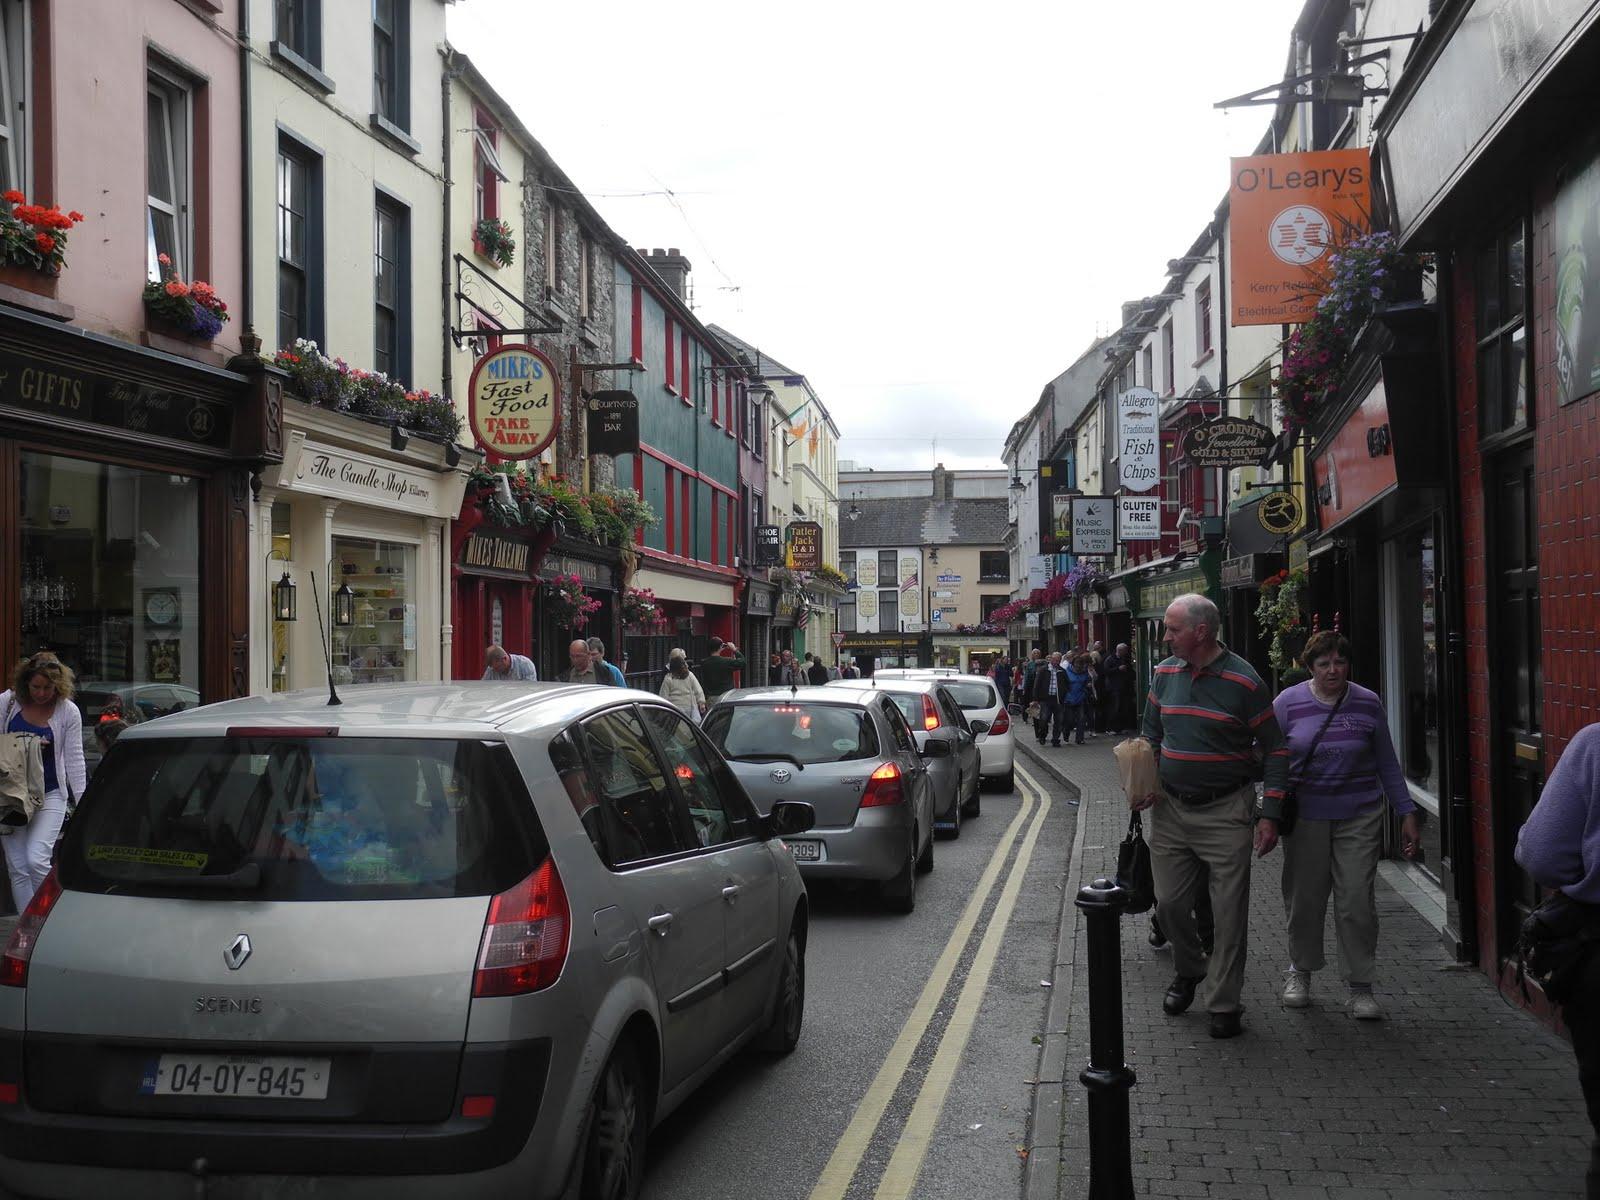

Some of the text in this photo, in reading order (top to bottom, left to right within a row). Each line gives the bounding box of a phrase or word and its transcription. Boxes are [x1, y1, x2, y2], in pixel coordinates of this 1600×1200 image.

[1236, 166, 1364, 193] O'Learys
[1250, 281, 1280, 294] Kerry
[1238, 304, 1288, 317] Electrical
[488, 355, 544, 380] MIKE'S
[20, 368, 82, 409] GIFTS
[481, 381, 532, 400] Fast
[490, 394, 548, 416] Food
[1121, 394, 1156, 409] Allegro
[484, 417, 529, 432] TAKE
[603, 422, 622, 432] BAR
[1122, 423, 1156, 434] Traditional
[491, 429, 540, 444] AWAY
[1124, 438, 1155, 456] Fish
[1191, 447, 1267, 458] GOLD & SILVER
[1200, 457, 1227, 467] Antique
[310, 455, 336, 479] The
[340, 461, 380, 489] Candle
[381, 472, 407, 501] Shop
[1123, 463, 1157, 481] Chips
[1122, 501, 1158, 511] GLUTEN
[1075, 518, 1103, 527] MUSIC
[1129, 512, 1152, 522] FREE
[758, 528, 778, 536] SHOE
[792, 526, 817, 537] Tatler
[1075, 527, 1112, 536] EXPRESS
[757, 537, 779, 545] FLAIR
[794, 536, 814, 546] Jack
[792, 545, 816, 553] B & B
[159, 851, 181, 859] SALES
[194, 995, 263, 1014] SCENIC
